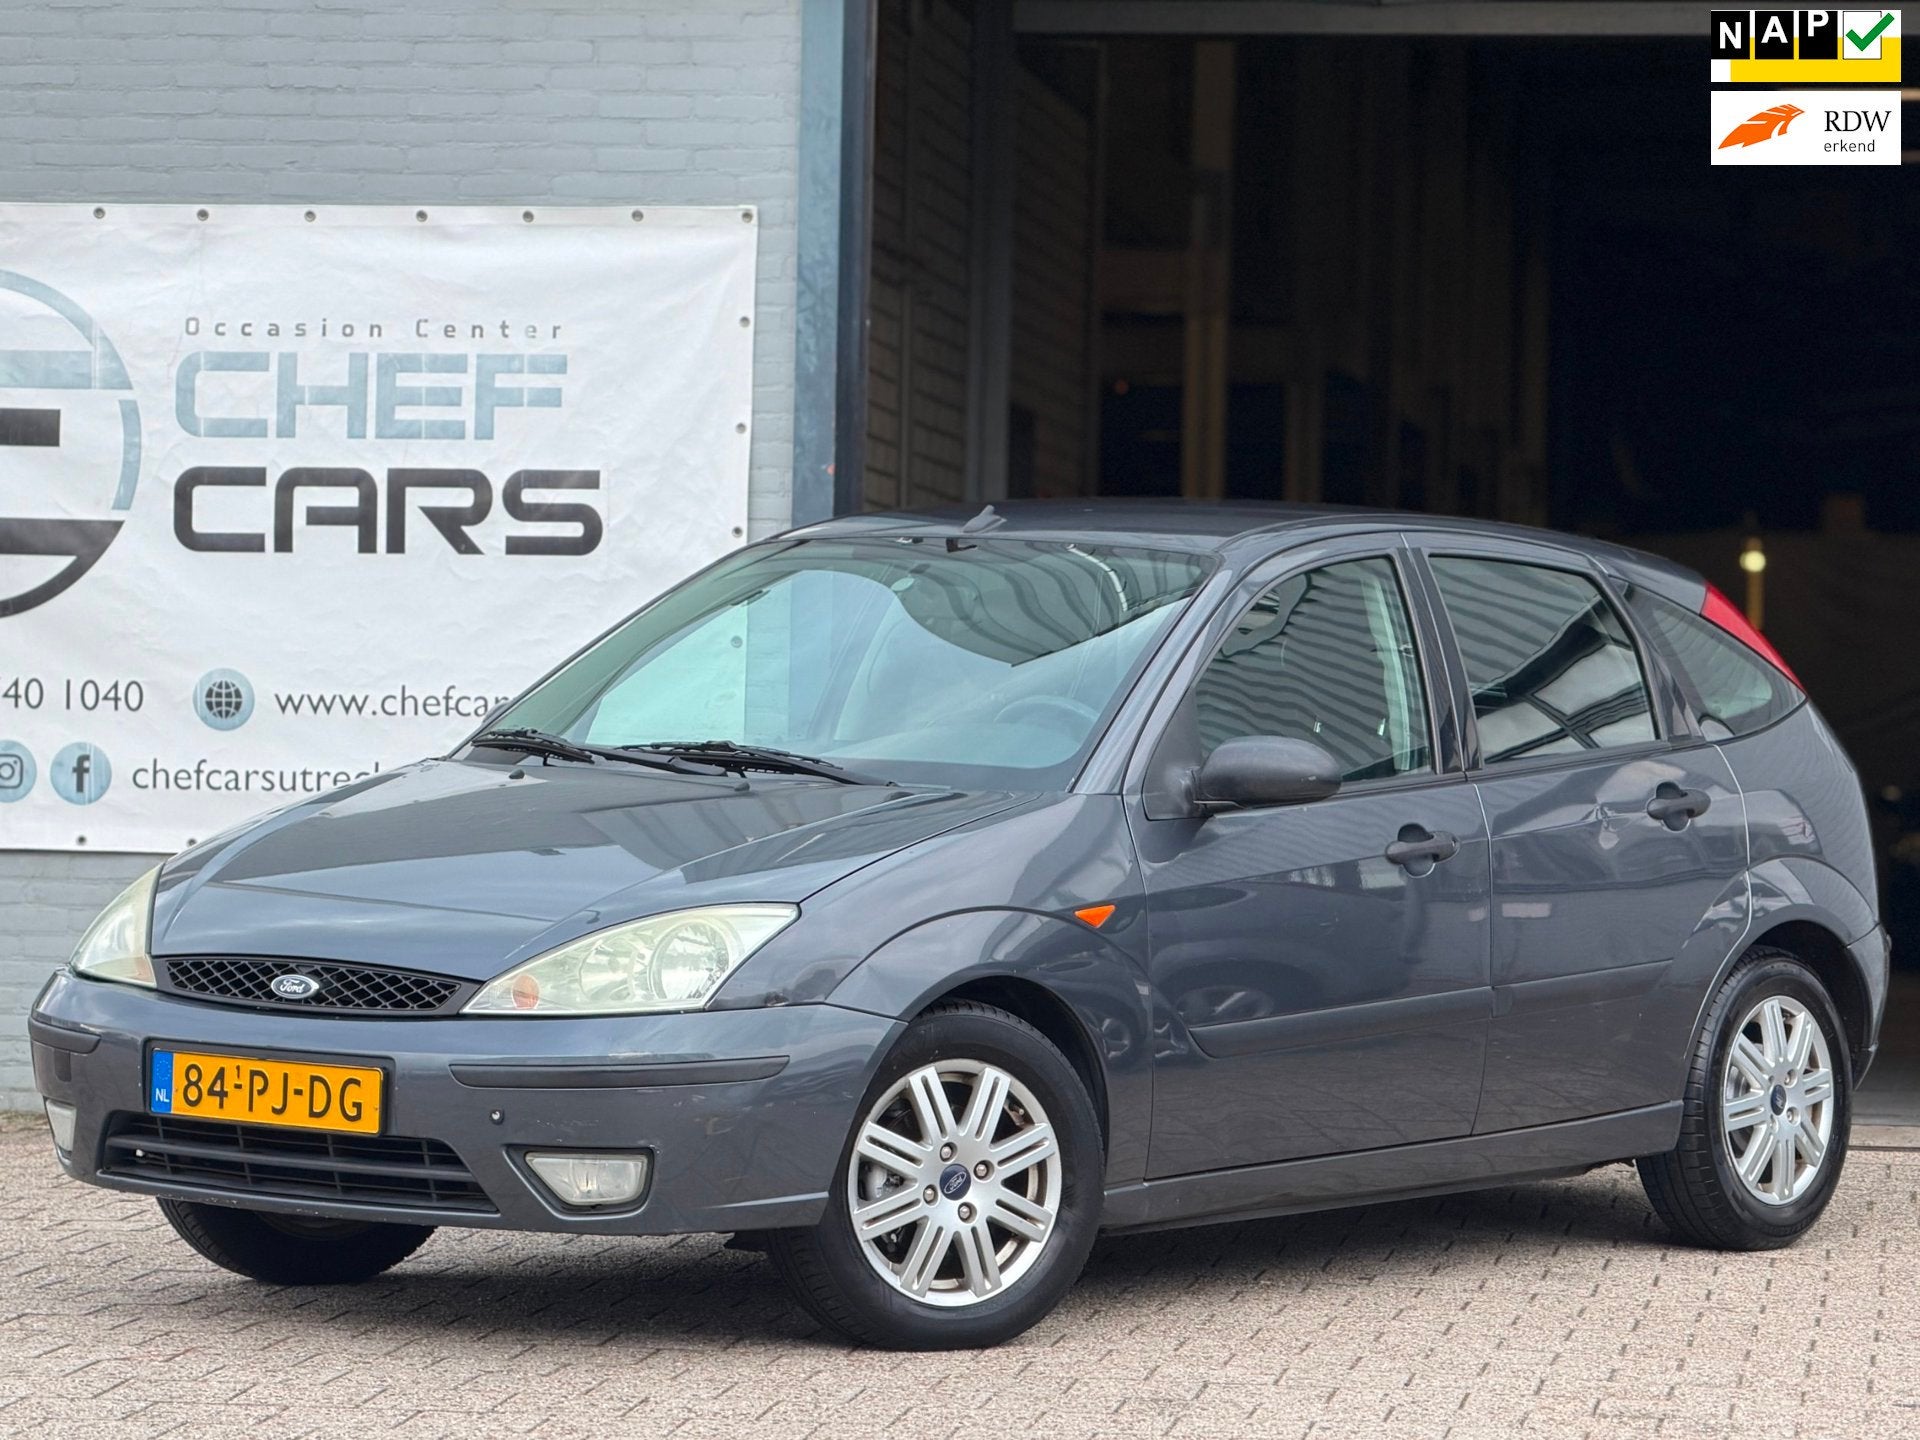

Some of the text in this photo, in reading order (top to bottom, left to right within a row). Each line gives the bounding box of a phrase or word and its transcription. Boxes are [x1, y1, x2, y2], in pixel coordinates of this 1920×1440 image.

[184, 316, 563, 339] Occasion Center
[175, 351, 568, 441] CHEF
[173, 466, 604, 556] CARS
[65, 678, 144, 712] 1040
[280, 978, 306, 994] Ford
[155, 1088, 170, 1103] NL
